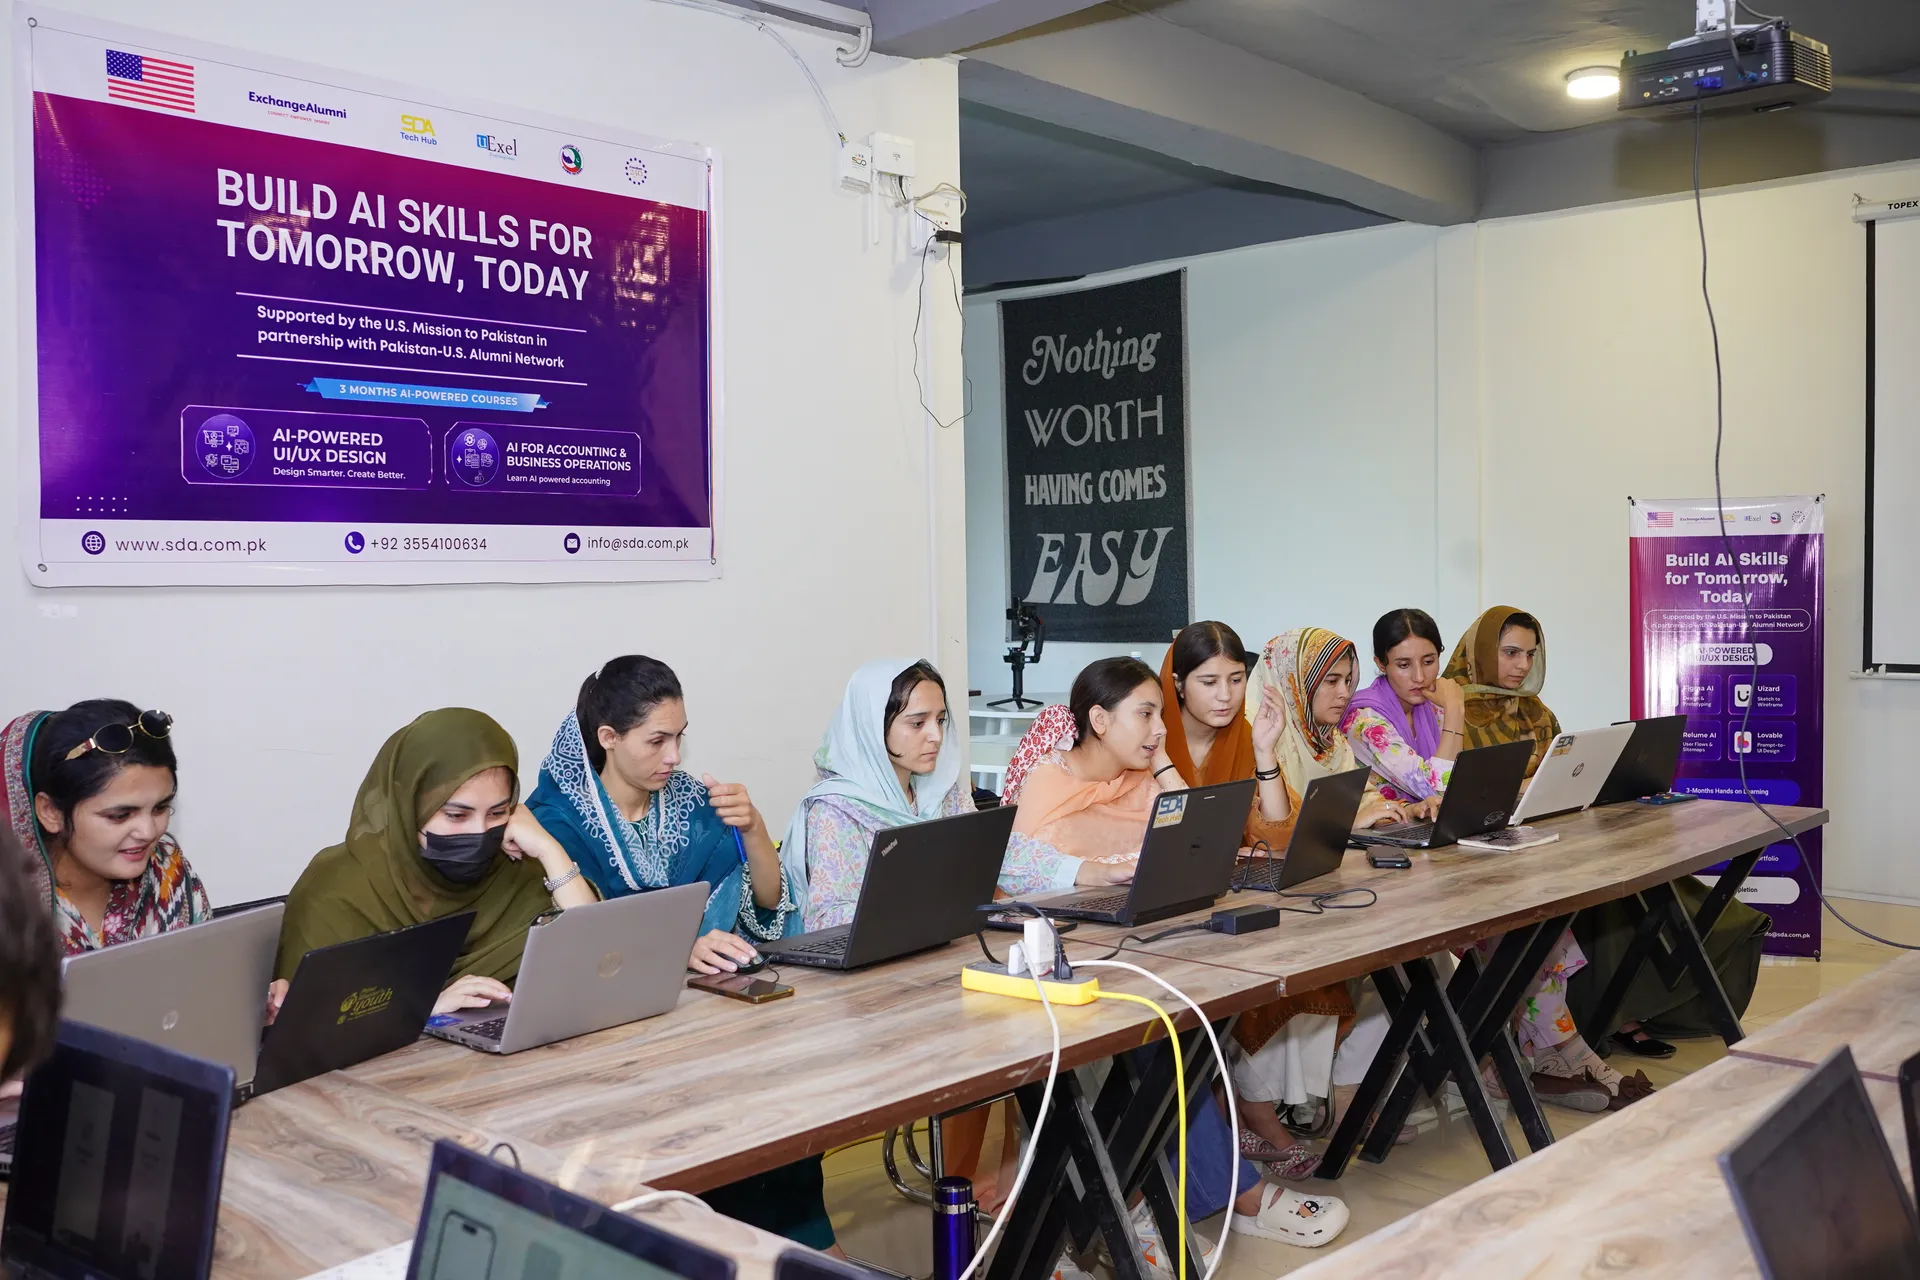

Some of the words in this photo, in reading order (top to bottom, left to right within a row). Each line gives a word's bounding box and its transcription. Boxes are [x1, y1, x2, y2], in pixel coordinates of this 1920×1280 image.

[248, 91, 347, 119] ExchangeAlumni
[401, 114, 436, 136] SDA
[400, 132, 419, 142] Tech
[421, 136, 437, 146] Hub
[476, 134, 518, 156] uExel
[216, 168, 338, 220] BUILD
[348, 191, 386, 229] AI
[398, 198, 520, 249] SKILLS
[529, 218, 594, 260] FOR
[1888, 200, 1919, 210] TOPEX
[216, 219, 465, 293] TOMORROW,
[473, 254, 590, 301] TODAY
[257, 305, 335, 326] Supported
[338, 313, 356, 330] by
[359, 315, 382, 330] the
[385, 319, 410, 333] U.S.
[413, 322, 462, 338] Mission
[465, 327, 478, 340] to
[481, 329, 534, 346] Pakistan
[537, 333, 548, 347] in
[257, 328, 344, 350] partnership
[347, 334, 377, 351] with
[380, 339, 467, 360] Pakistan-U.S.
[470, 347, 512, 364] Alumni
[515, 352, 565, 368] Network
[1022, 326, 1162, 386] Nothing
[339, 384, 347, 394] 3
[350, 385, 398, 399] MONTHS
[400, 387, 469, 404] AI-POWERED
[471, 394, 519, 406] COURSES
[1024, 394, 1164, 448] WORTH
[272, 428, 383, 447] AI-POWERED
[273, 446, 321, 463] UI/UX
[325, 449, 387, 465] DESIGN
[506, 442, 518, 453] AI
[521, 443, 545, 454] FOR
[546, 444, 617, 458] ACCOUNTING
[619, 448, 627, 458] &
[507, 455, 562, 469] BUSINESS
[564, 458, 632, 472] OPERATIONS
[273, 467, 306, 478] Design
[307, 468, 346, 478] Smarter.
[347, 470, 376, 479] Create
[378, 470, 406, 480] Better.
[507, 474, 528, 483] Learn
[529, 475, 537, 483] AI
[538, 476, 570, 485] powered
[571, 478, 611, 487] accounting
[1024, 471, 1093, 505] HAVING
[1098, 464, 1168, 503] COMES
[115, 537, 267, 555] www.sda.com.pk
[371, 537, 398, 551] +92
[403, 537, 487, 551] 3554100634
[587, 536, 689, 551] info@sda.com.pk
[1022, 526, 1174, 607] EASY
[1665, 553, 1709, 567] Build
[1715, 553, 1733, 566] AI
[1739, 552, 1789, 566] Skills
[1665, 571, 1690, 585] for
[1694, 572, 1788, 587] Tomorrow,
[1700, 590, 1753, 606] Today
[1699, 647, 1754, 655] AI-POWERED
[1686, 787, 1714, 795] 3-Months
[1714, 787, 1732, 795] Hands
[1158, 795, 1183, 815] SDA
[1156, 815, 1168, 824] Tech
